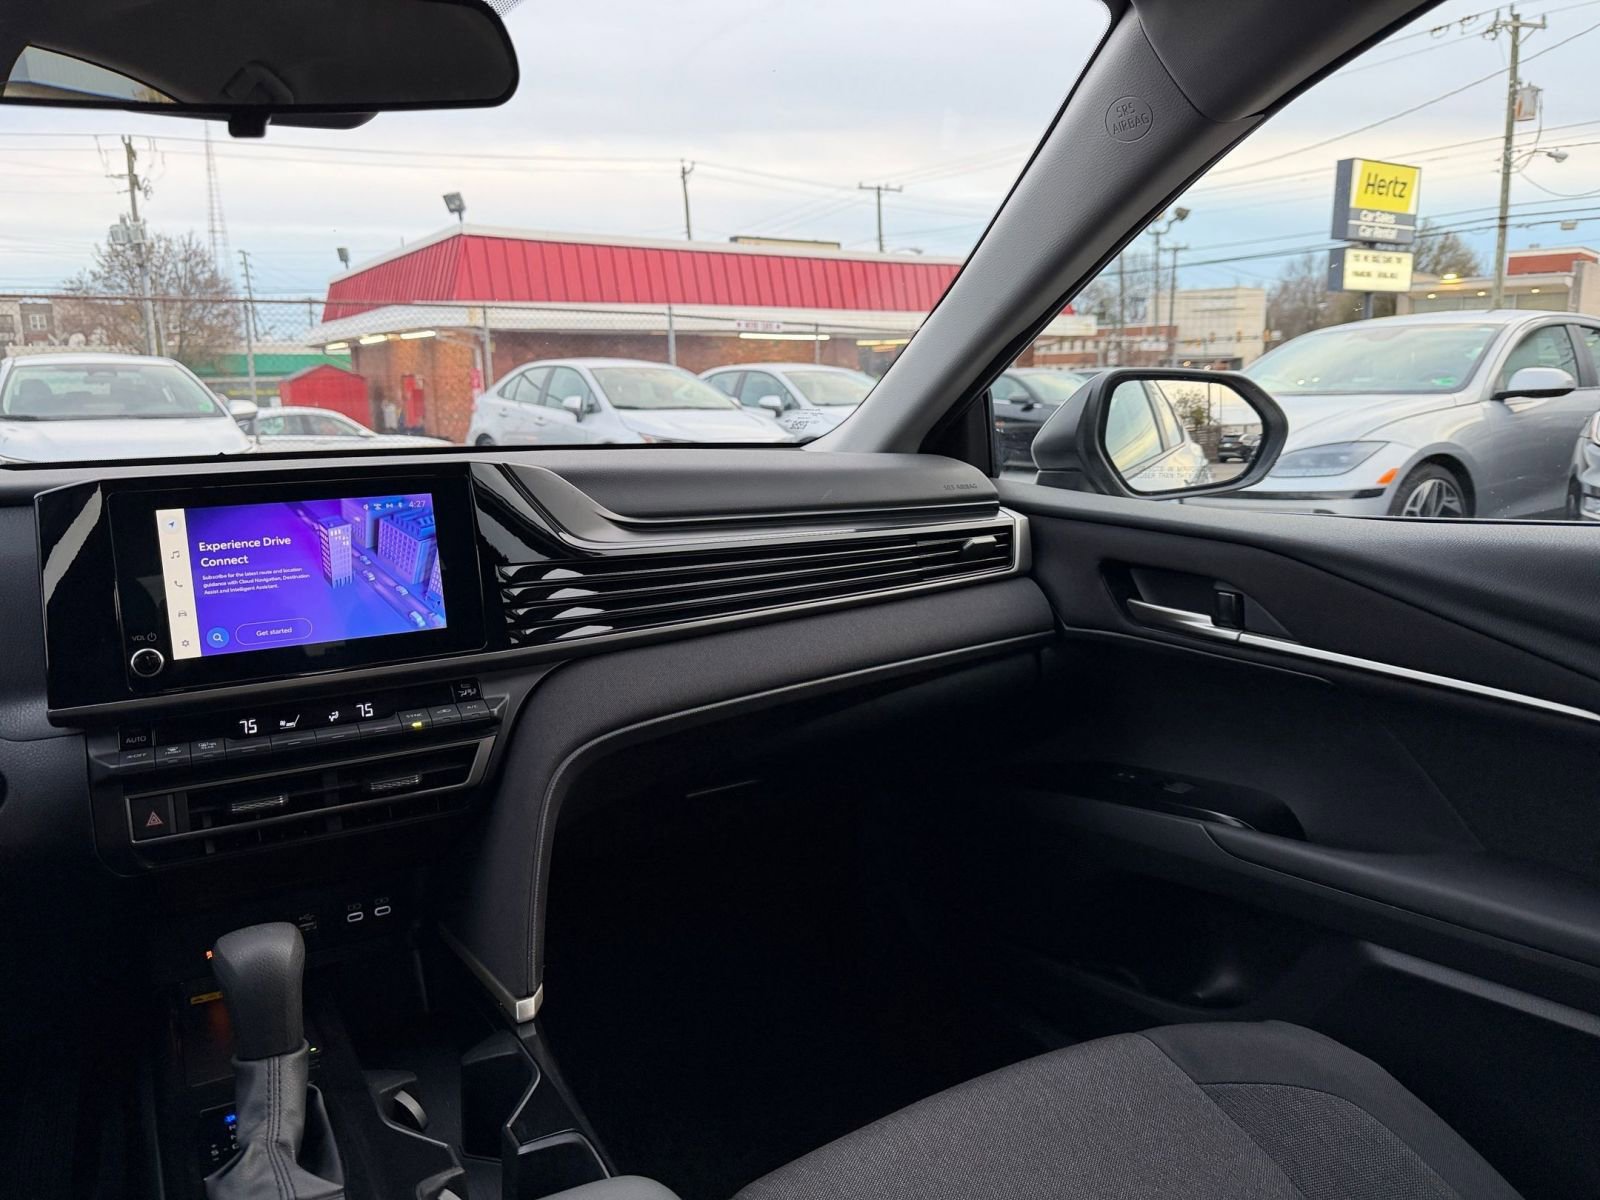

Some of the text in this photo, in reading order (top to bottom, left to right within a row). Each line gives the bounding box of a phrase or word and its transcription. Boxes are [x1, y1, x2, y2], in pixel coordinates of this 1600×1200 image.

[1116, 102, 1135, 118] SRS
[1113, 112, 1149, 135] AIRBAG
[1363, 172, 1408, 199] Hertz
[408, 500, 426, 508] 4:27
[198, 536, 292, 552] Experience Drive
[200, 555, 249, 567] Connect
[203, 581, 227, 589] guidance
[230, 585, 256, 593] Intelligent
[269, 627, 293, 635] started
[355, 702, 374, 718] 75
[239, 719, 258, 735] 75
[126, 735, 147, 744] AUTO
